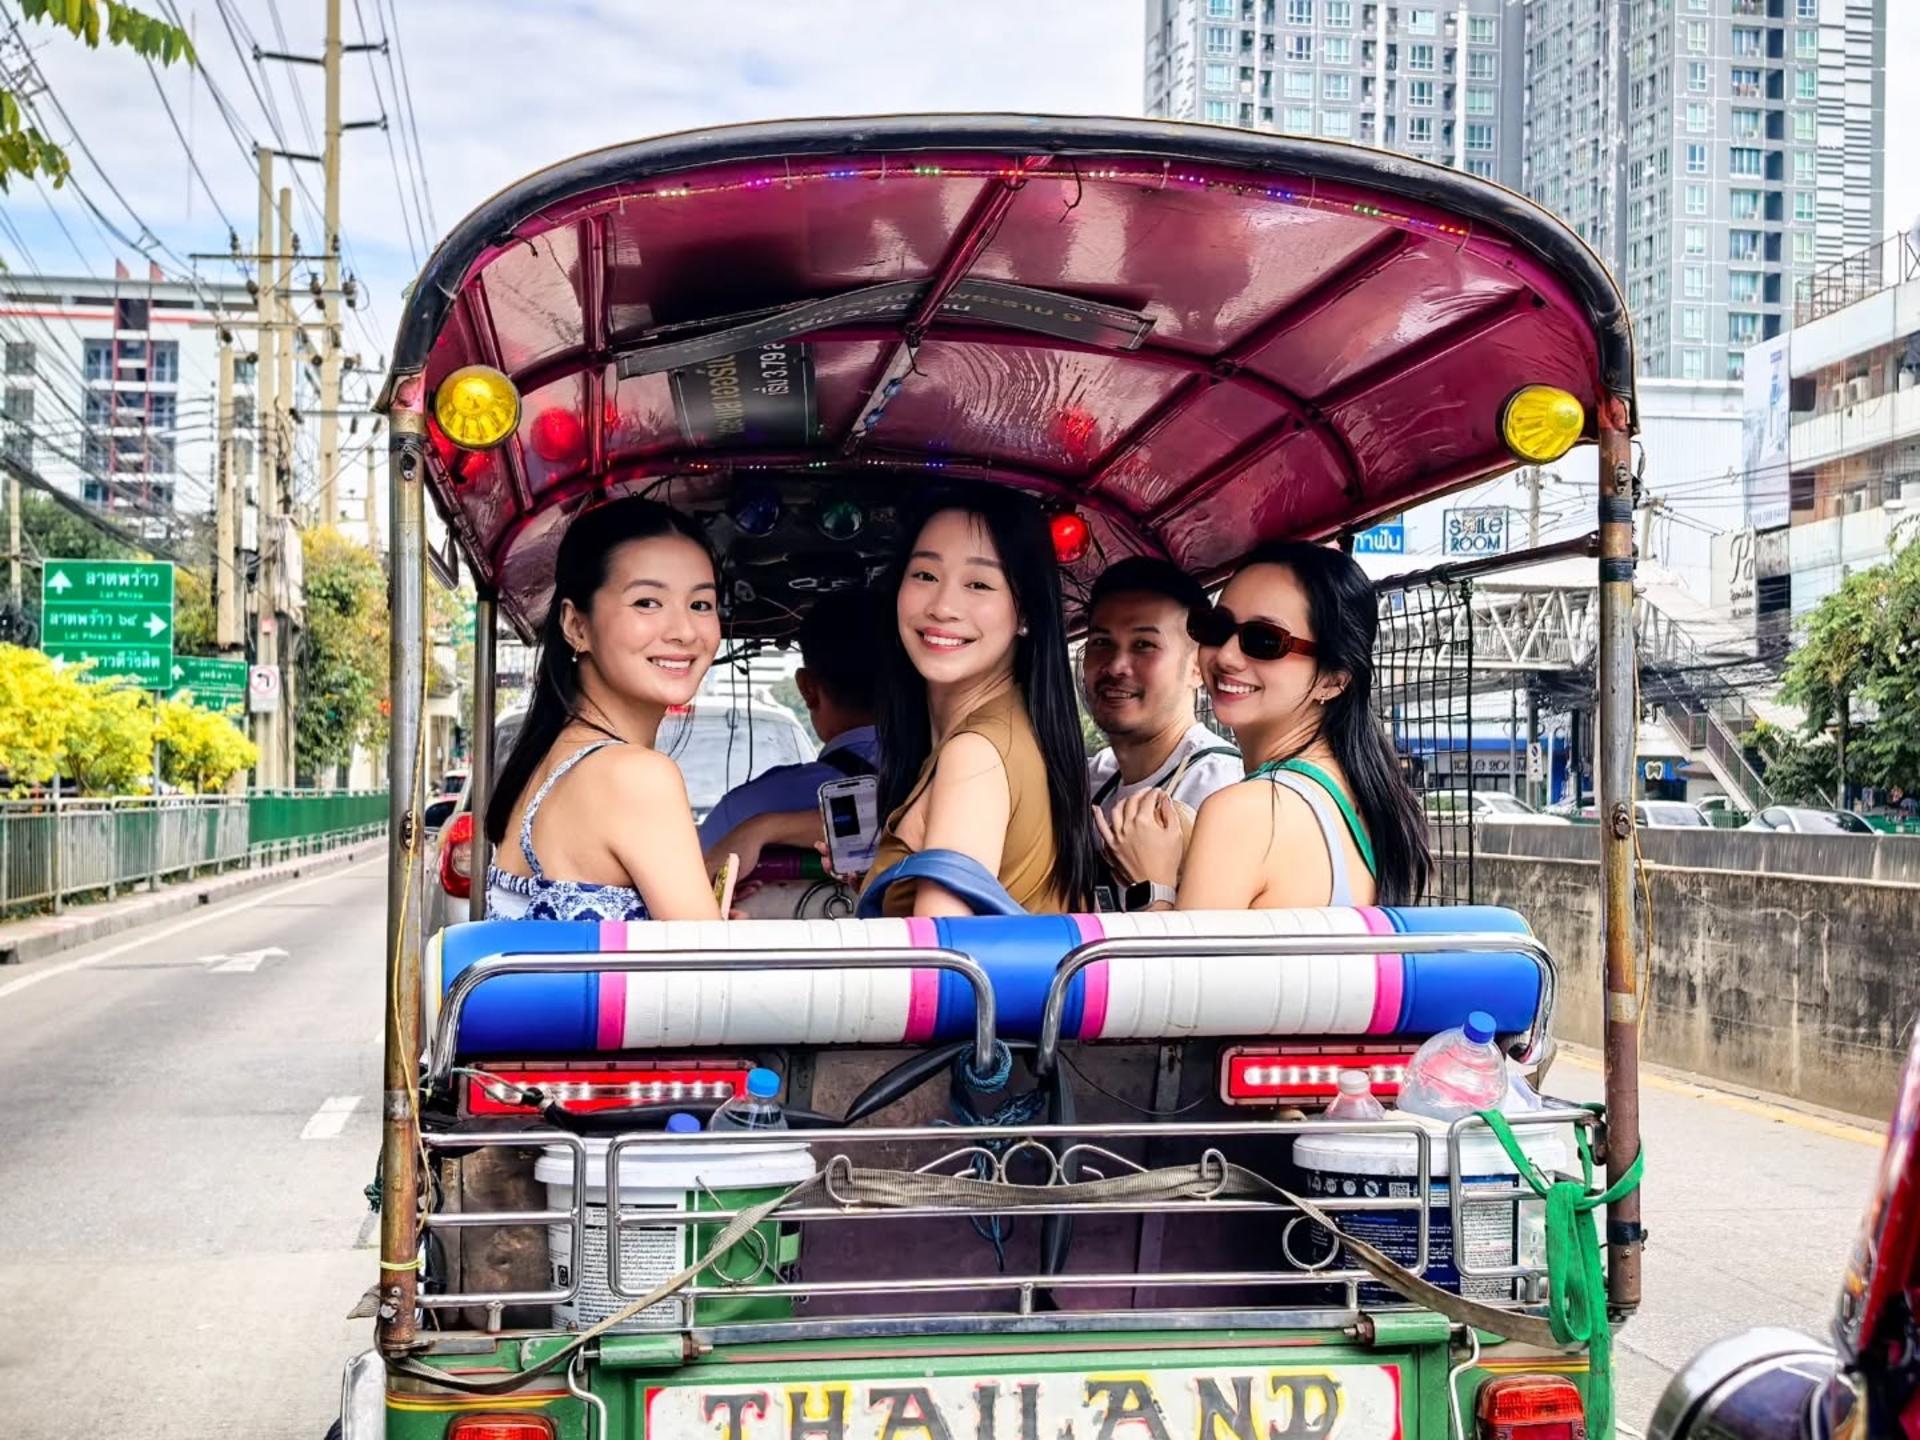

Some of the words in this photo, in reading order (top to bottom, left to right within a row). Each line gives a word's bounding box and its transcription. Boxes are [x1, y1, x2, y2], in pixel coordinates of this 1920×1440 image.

[759, 352, 789, 379] 3.79
[1450, 535, 1501, 552] ROOM
[703, 1374, 1342, 1440] THAILAND
